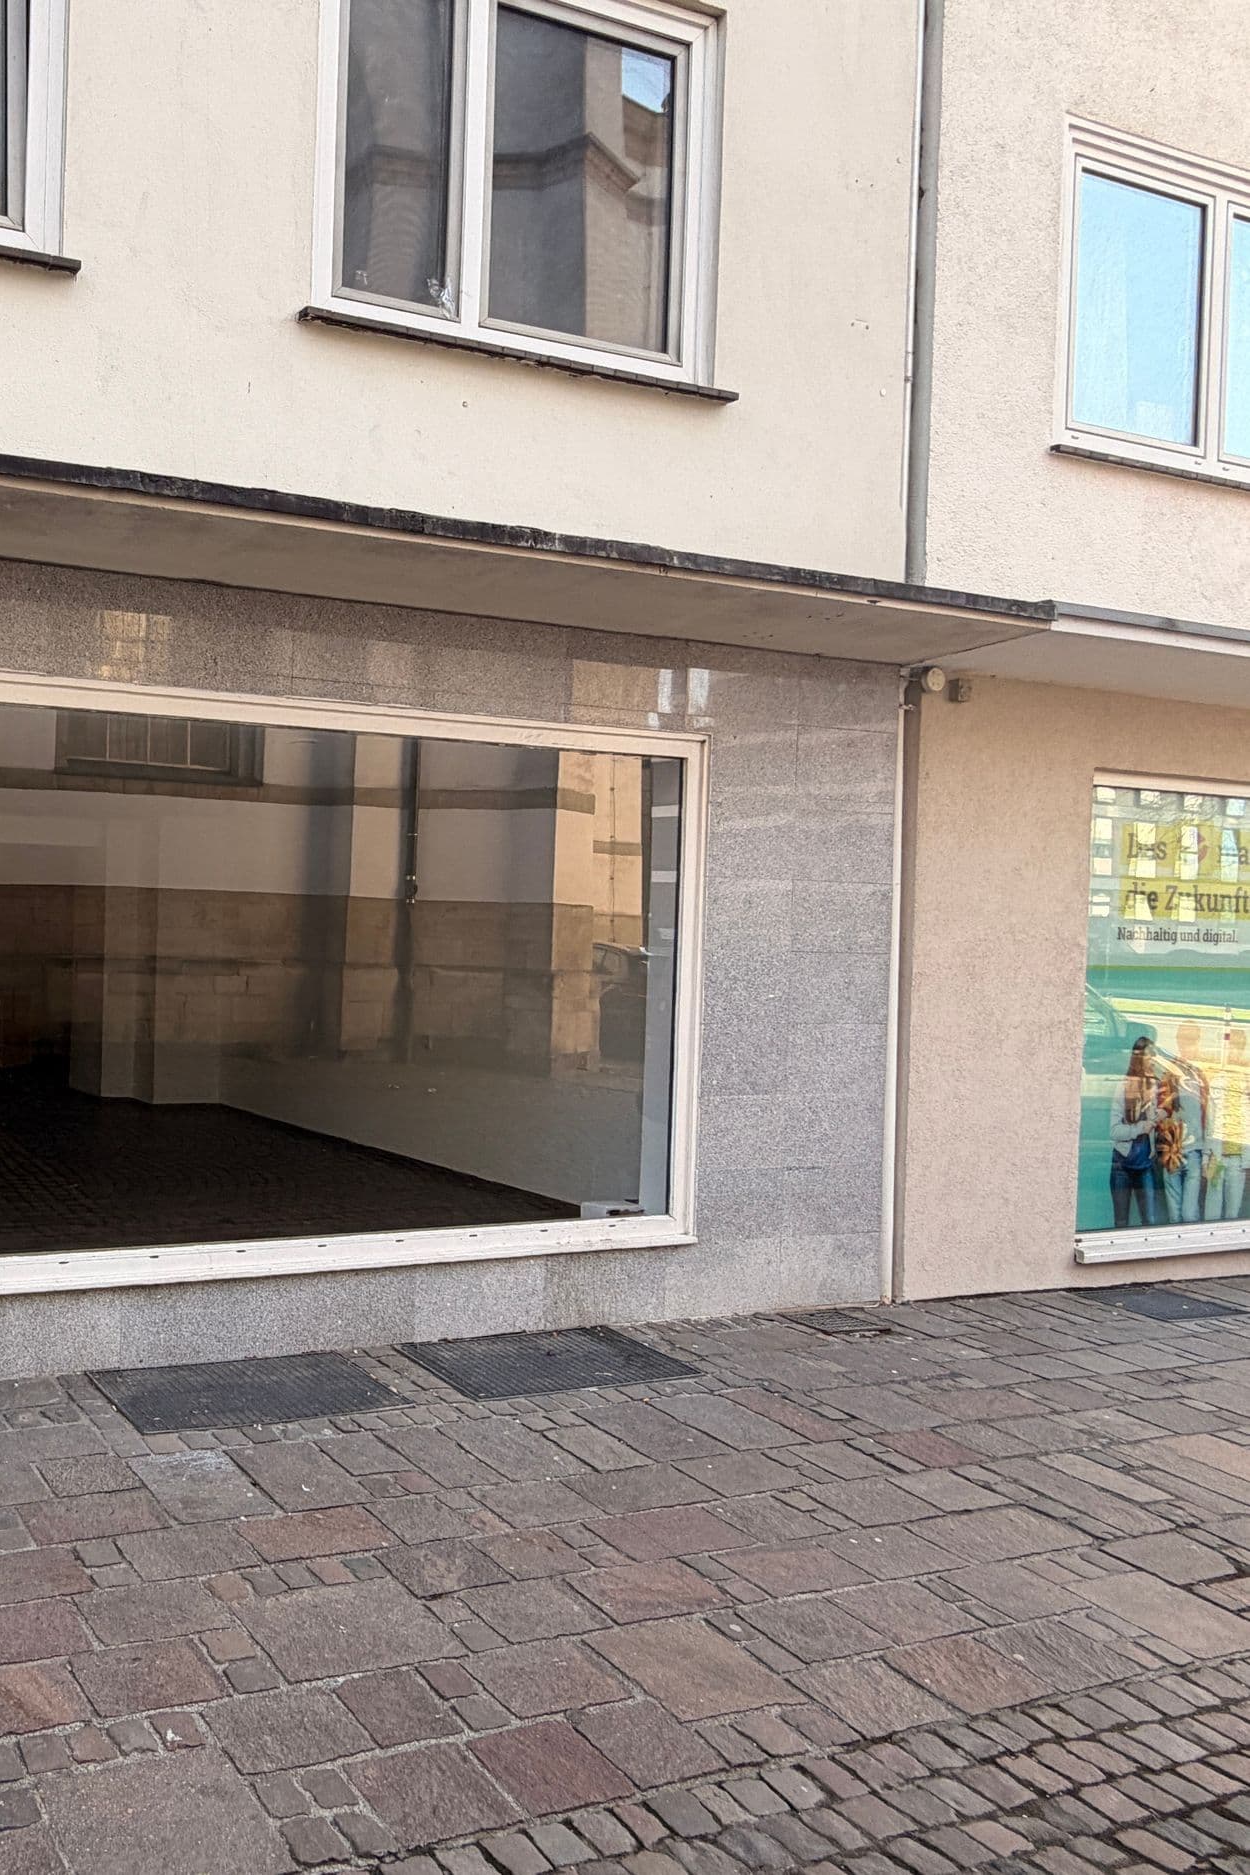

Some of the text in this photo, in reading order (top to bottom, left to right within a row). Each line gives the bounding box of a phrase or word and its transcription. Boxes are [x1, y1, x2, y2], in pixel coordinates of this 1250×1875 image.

[1165, 884, 1250, 914] Zkunft
[1117, 926, 1239, 946] Nachhaltig und digital.
